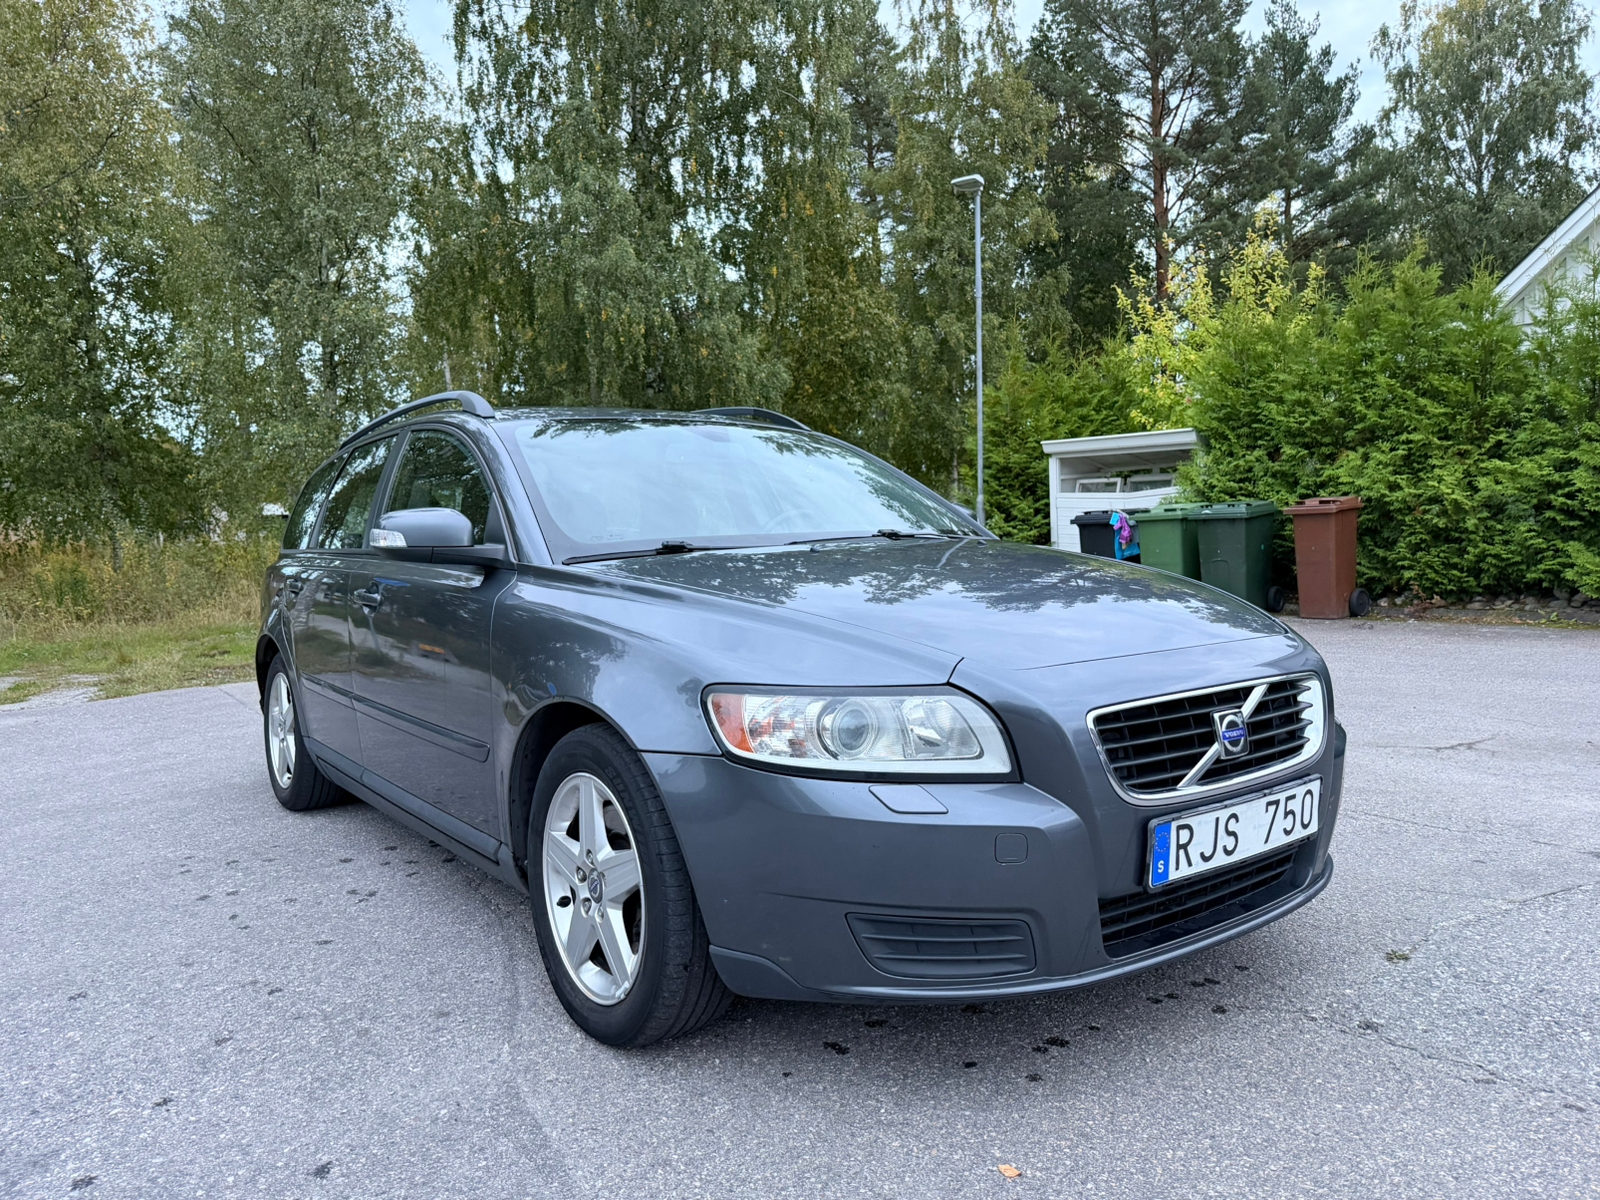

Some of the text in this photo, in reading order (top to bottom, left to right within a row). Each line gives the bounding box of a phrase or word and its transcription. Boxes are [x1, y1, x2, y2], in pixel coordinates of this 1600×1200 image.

[1223, 729, 1244, 738] VOLVO
[1175, 788, 1314, 871] RJS 750
[1157, 860, 1165, 873] S
